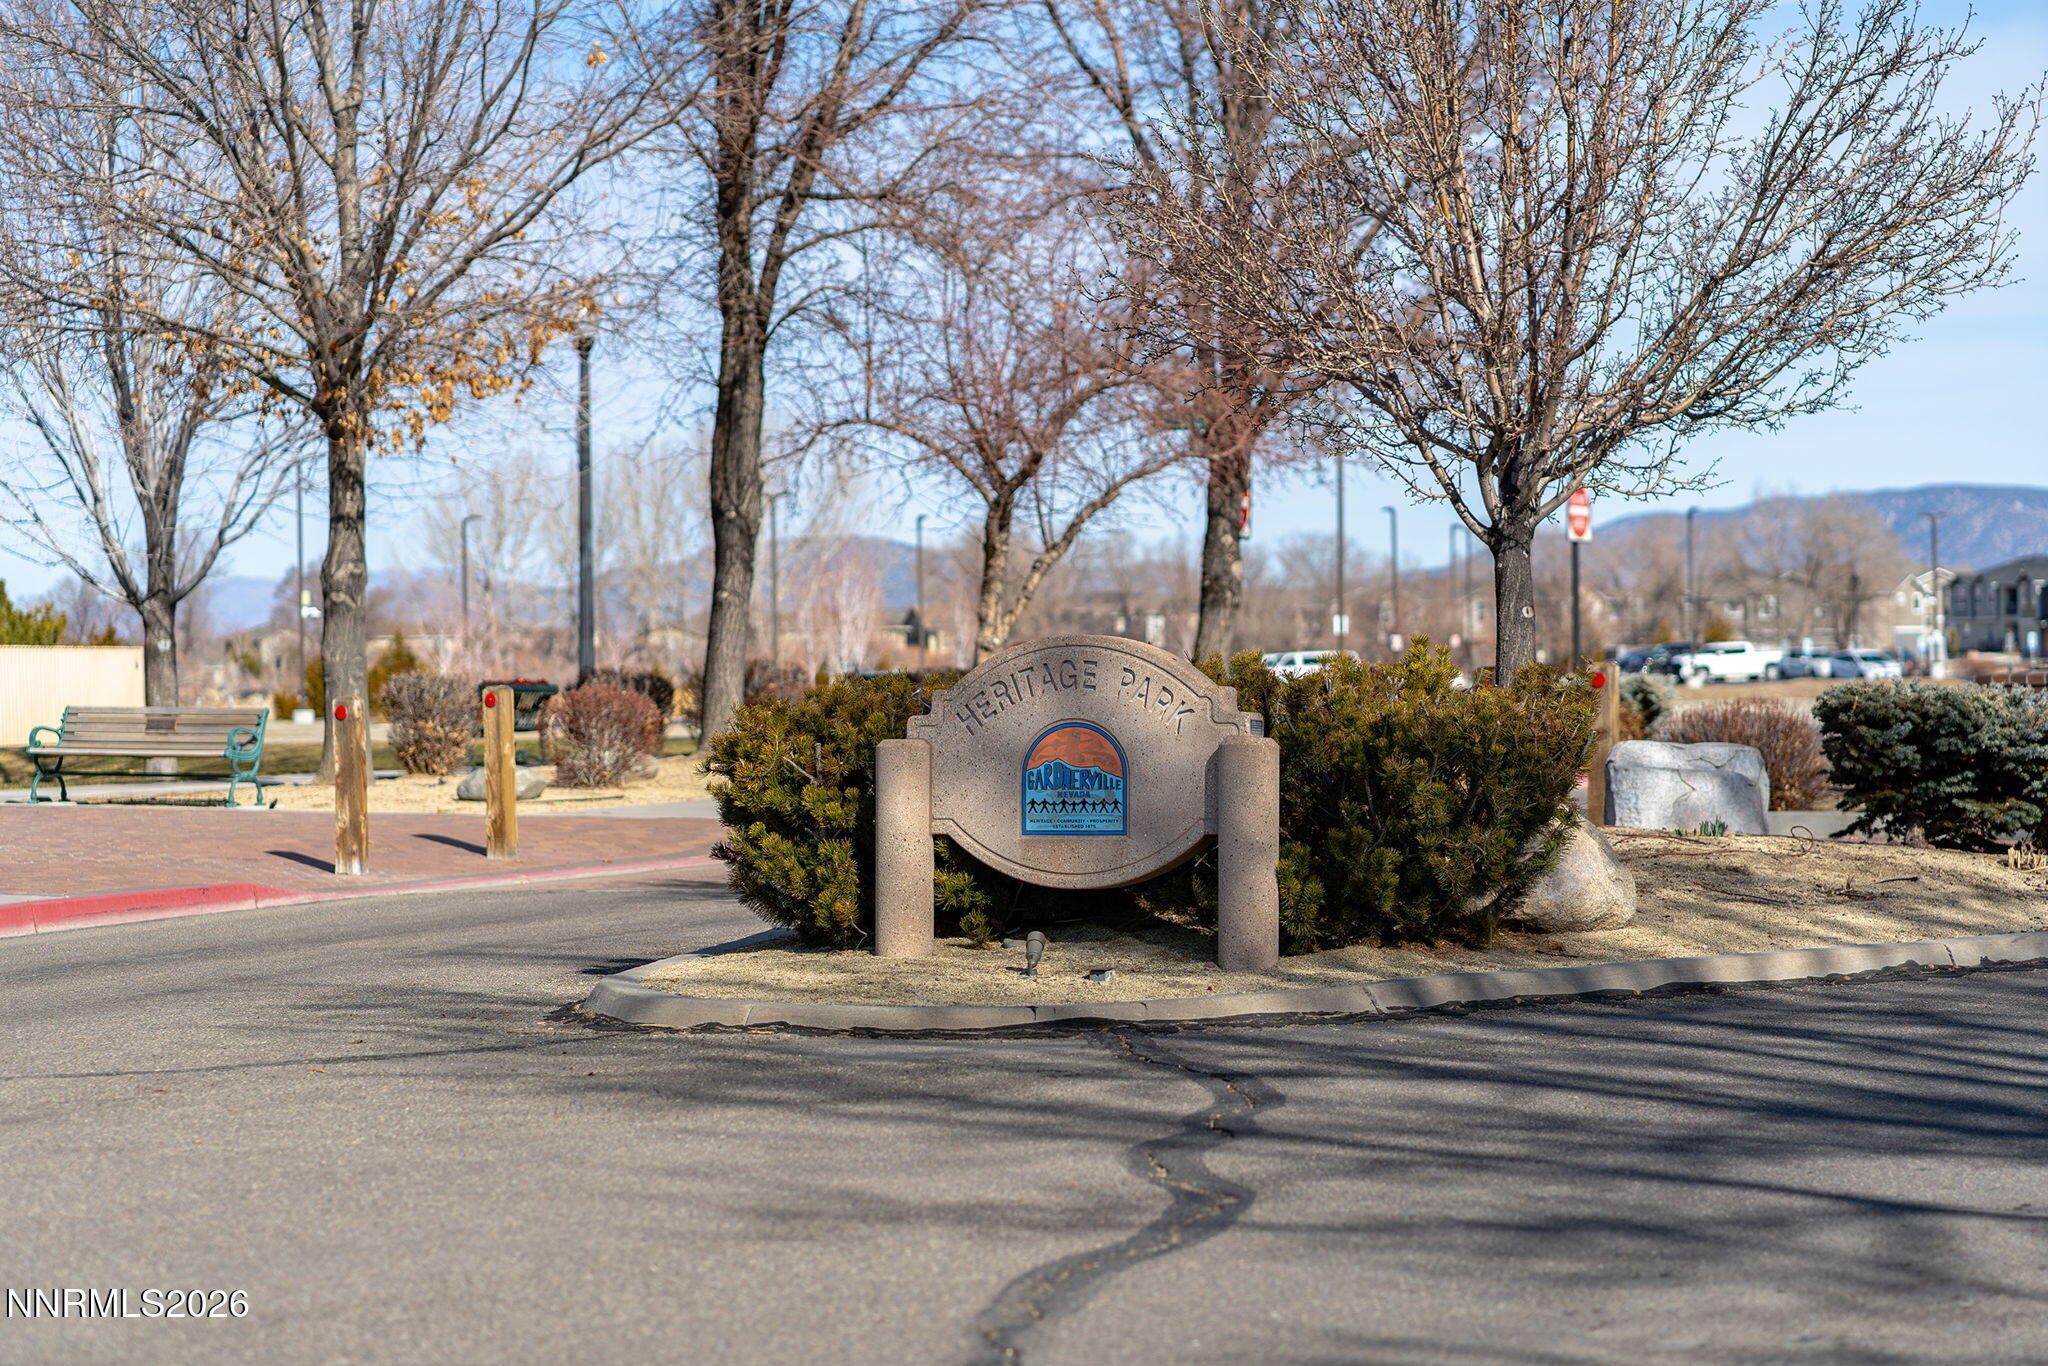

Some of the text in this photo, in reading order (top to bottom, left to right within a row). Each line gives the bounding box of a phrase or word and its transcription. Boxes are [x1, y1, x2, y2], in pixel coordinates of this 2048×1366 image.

[956, 660, 1195, 736] HERITAGE PARK
[1027, 762, 1122, 790] GARDNERVILLE
